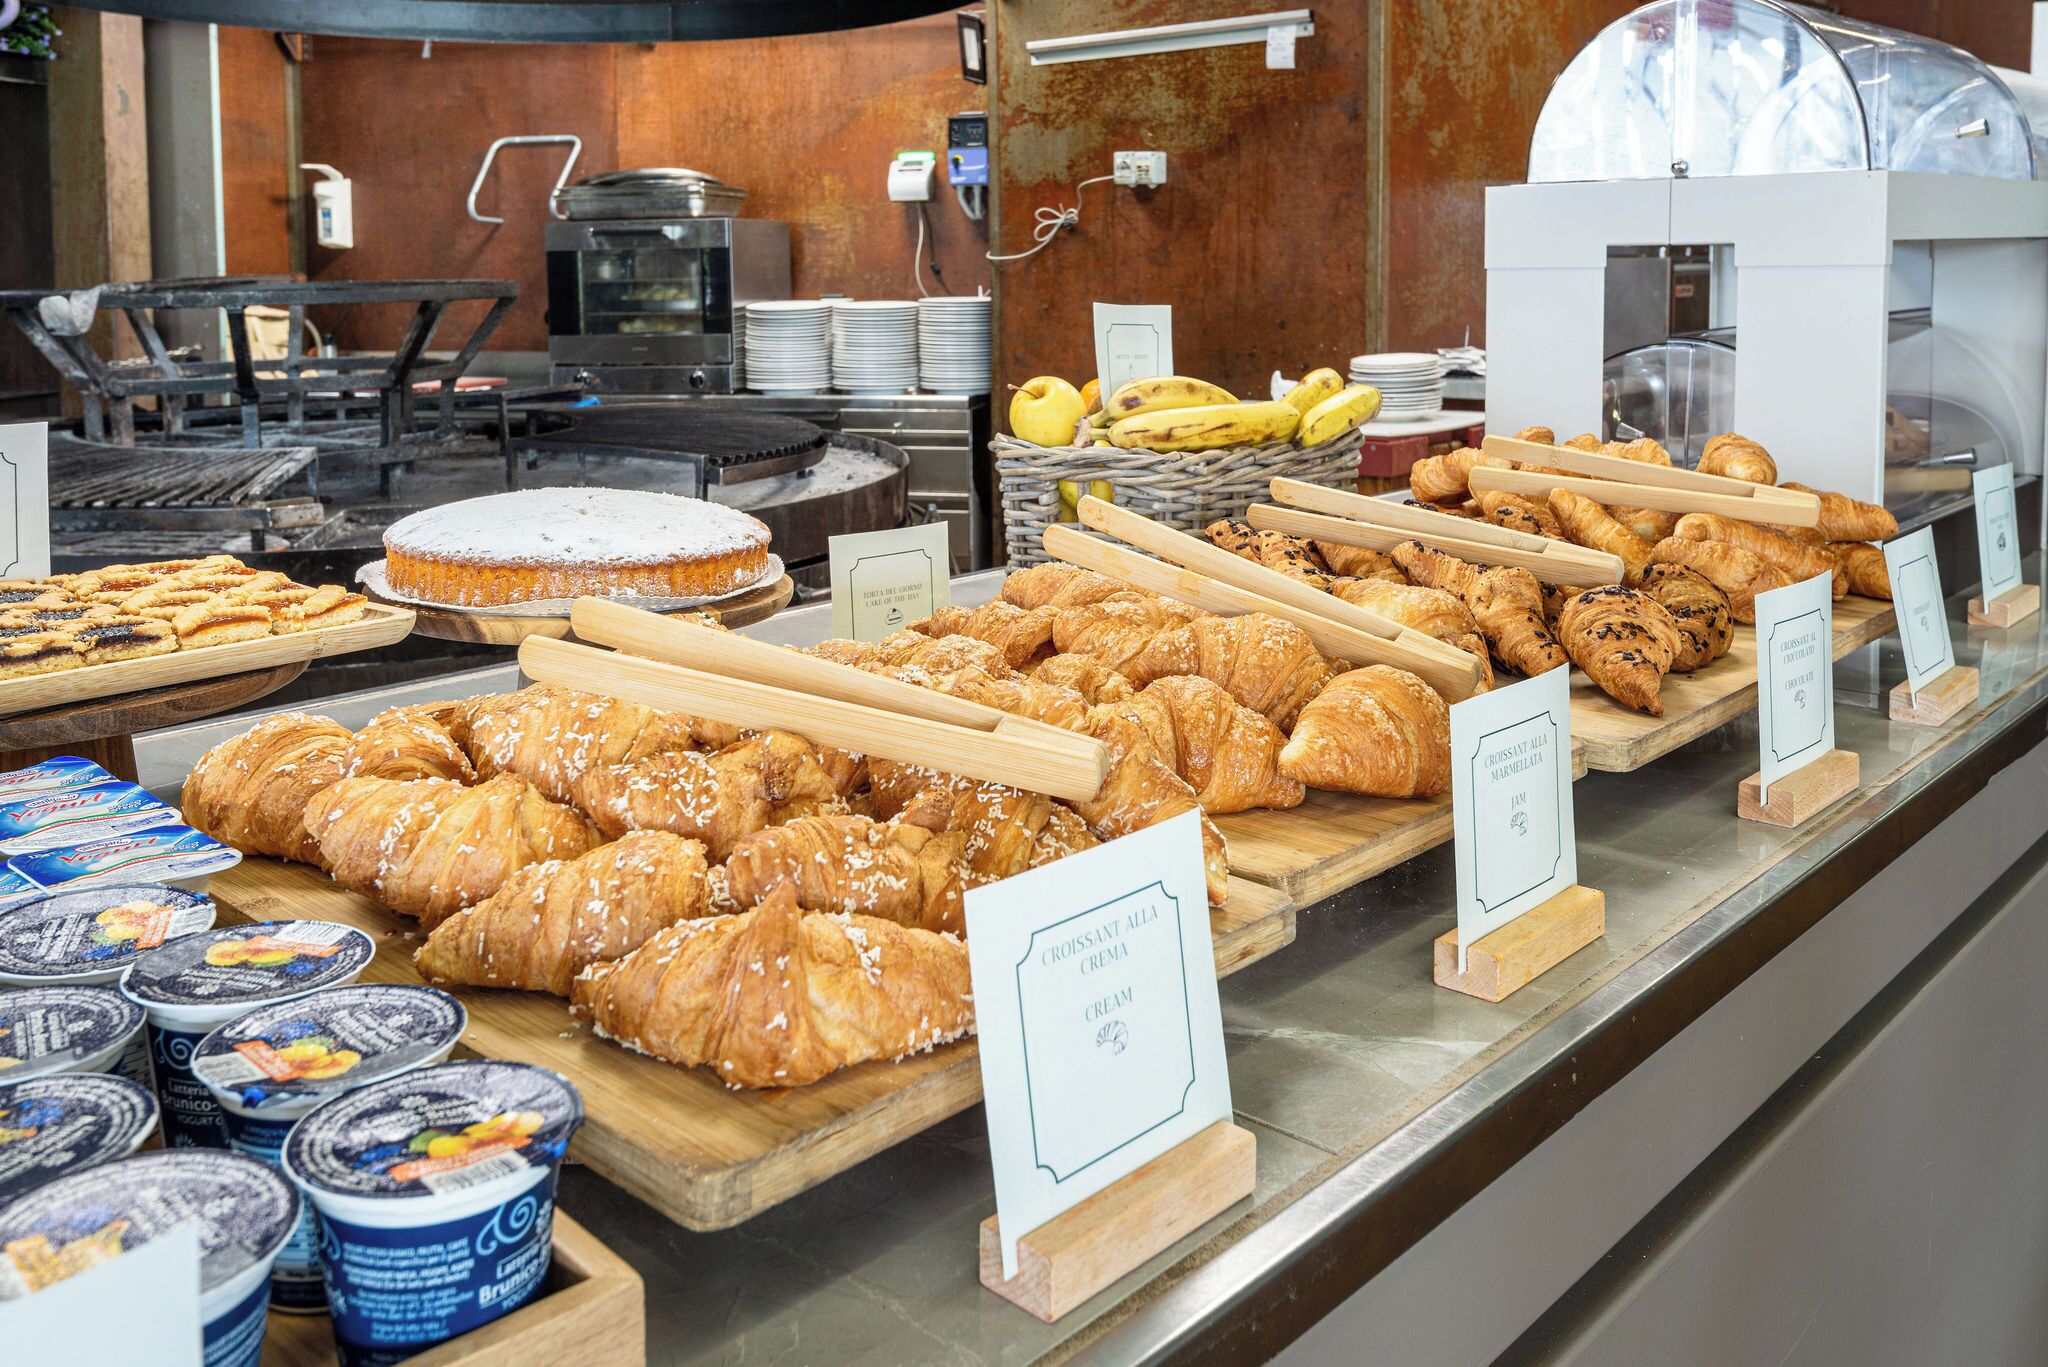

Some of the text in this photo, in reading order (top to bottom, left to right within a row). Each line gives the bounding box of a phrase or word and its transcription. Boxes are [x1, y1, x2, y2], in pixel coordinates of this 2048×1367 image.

[1780, 634, 1809, 653] CROISSANT
[1783, 645, 1815, 665] CIOCCOLATO
[1785, 671, 1815, 691] CHOCOLATE
[1484, 733, 1547, 768] CROISSANT ALLA
[1491, 752, 1543, 782] MARMELLATA
[1511, 792, 1526, 810] JAM
[1041, 905, 1158, 966] CROISSANT ALLA
[1080, 942, 1129, 976] CREMA
[1085, 986, 1133, 1023] CREAM
